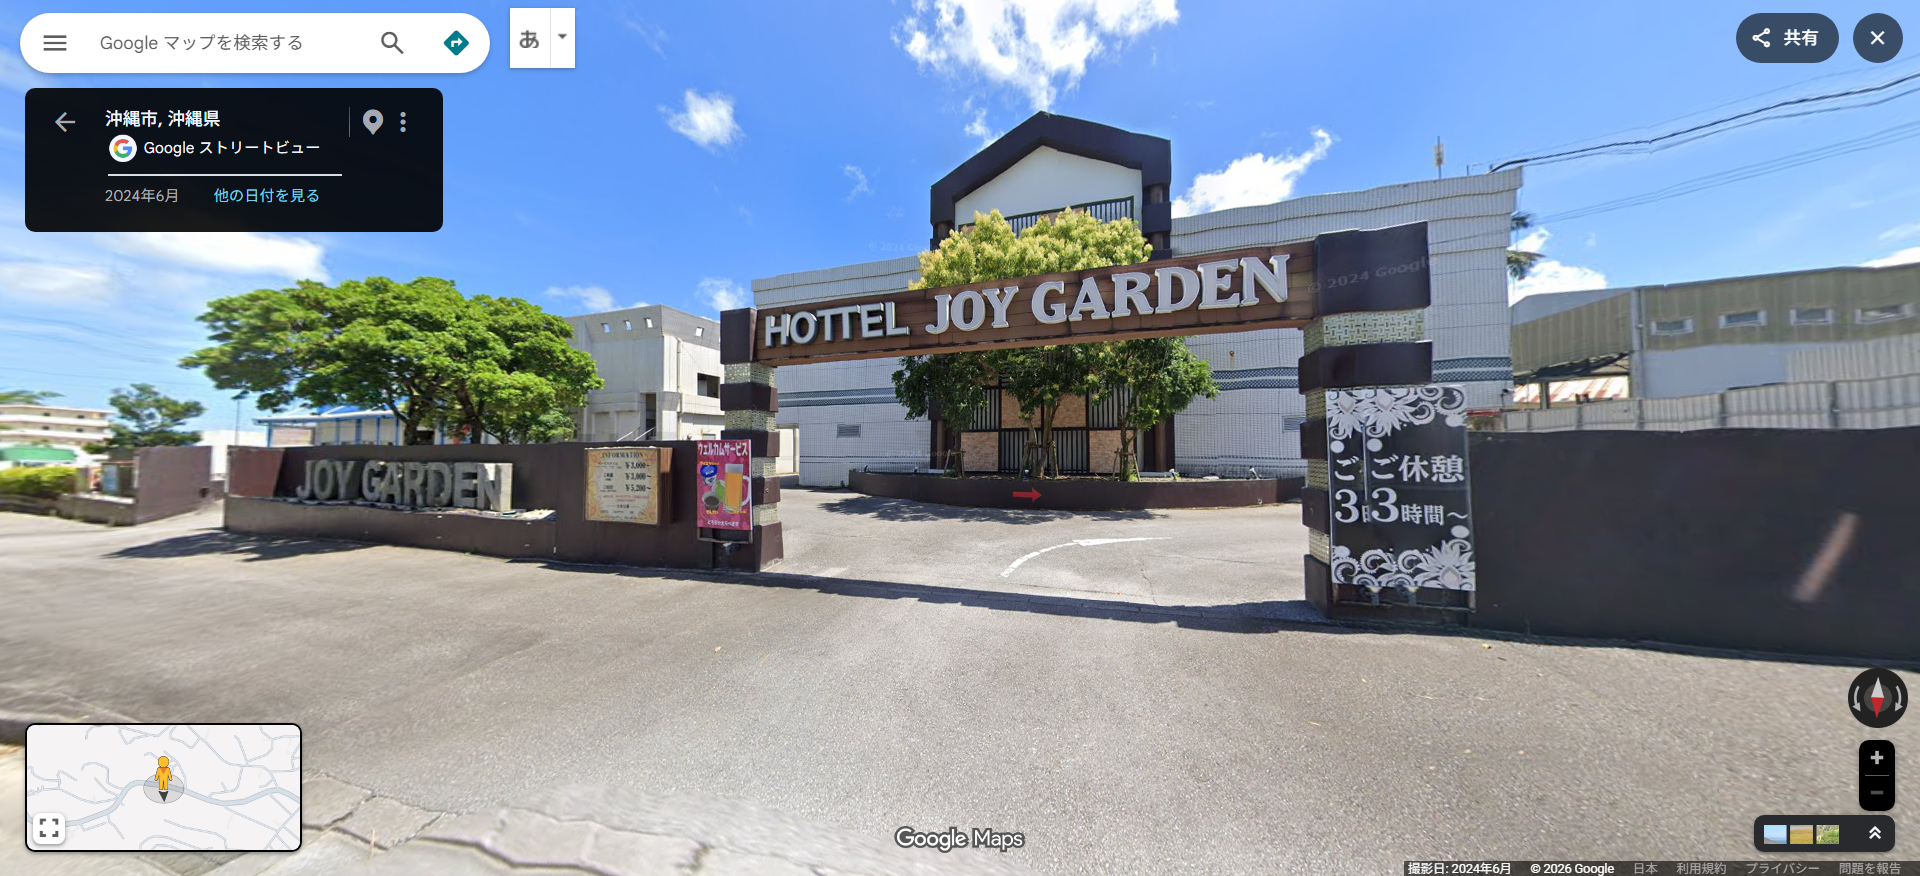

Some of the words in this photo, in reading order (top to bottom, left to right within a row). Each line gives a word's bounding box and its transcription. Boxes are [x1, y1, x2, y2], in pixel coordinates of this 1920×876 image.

[765, 301, 910, 347] HOTTEL
[925, 286, 1019, 335] JOY
[1031, 254, 1290, 324] GARDEN
[697, 442, 749, 457] ウェルカムサービス
[1371, 454, 1465, 483] ご休憩
[296, 459, 358, 501] JOY
[362, 459, 513, 511] GARDEN
